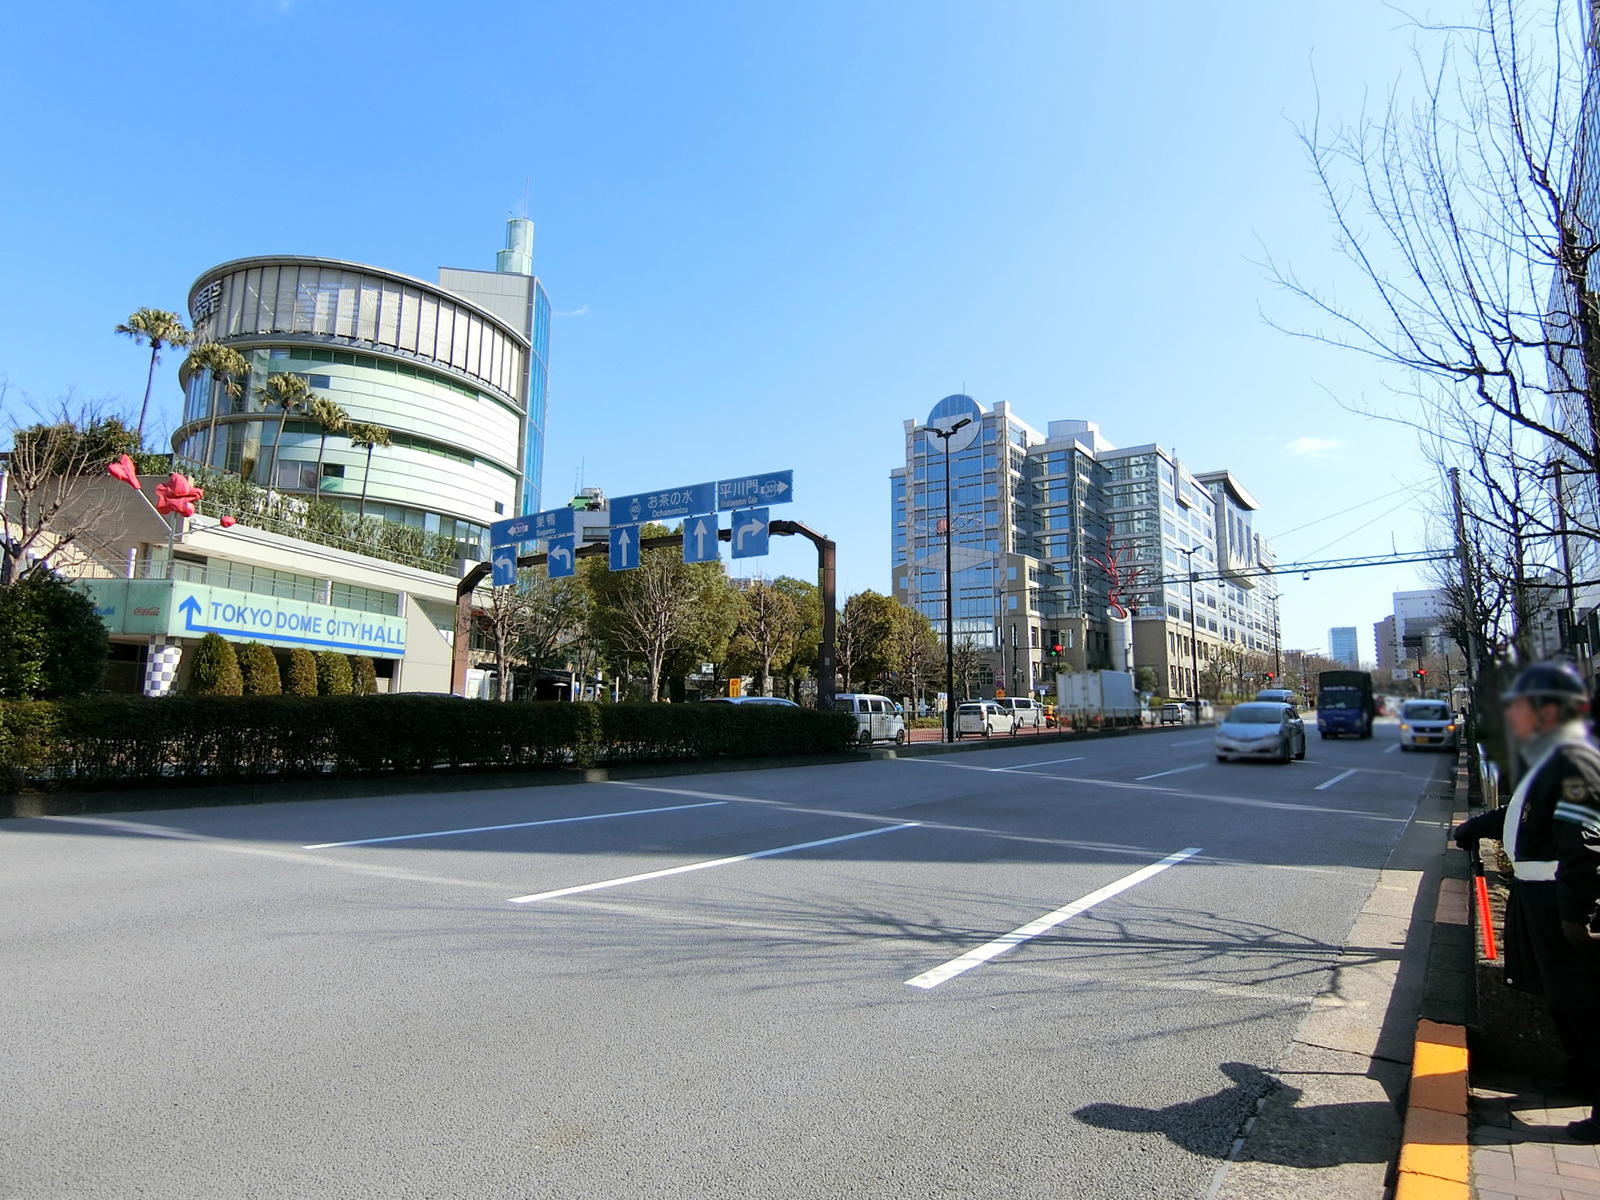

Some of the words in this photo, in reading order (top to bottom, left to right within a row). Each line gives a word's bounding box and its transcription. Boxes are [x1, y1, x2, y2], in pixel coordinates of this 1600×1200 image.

[720, 479, 758, 498] 平川門
[648, 490, 693, 508] お茶の水
[652, 507, 688, 518] Ochanomizu
[536, 528, 556, 537] Sugamo
[211, 602, 272, 627] TOKYO
[276, 611, 322, 633] DOME
[326, 619, 359, 638] CITY
[361, 623, 405, 645] HALL
